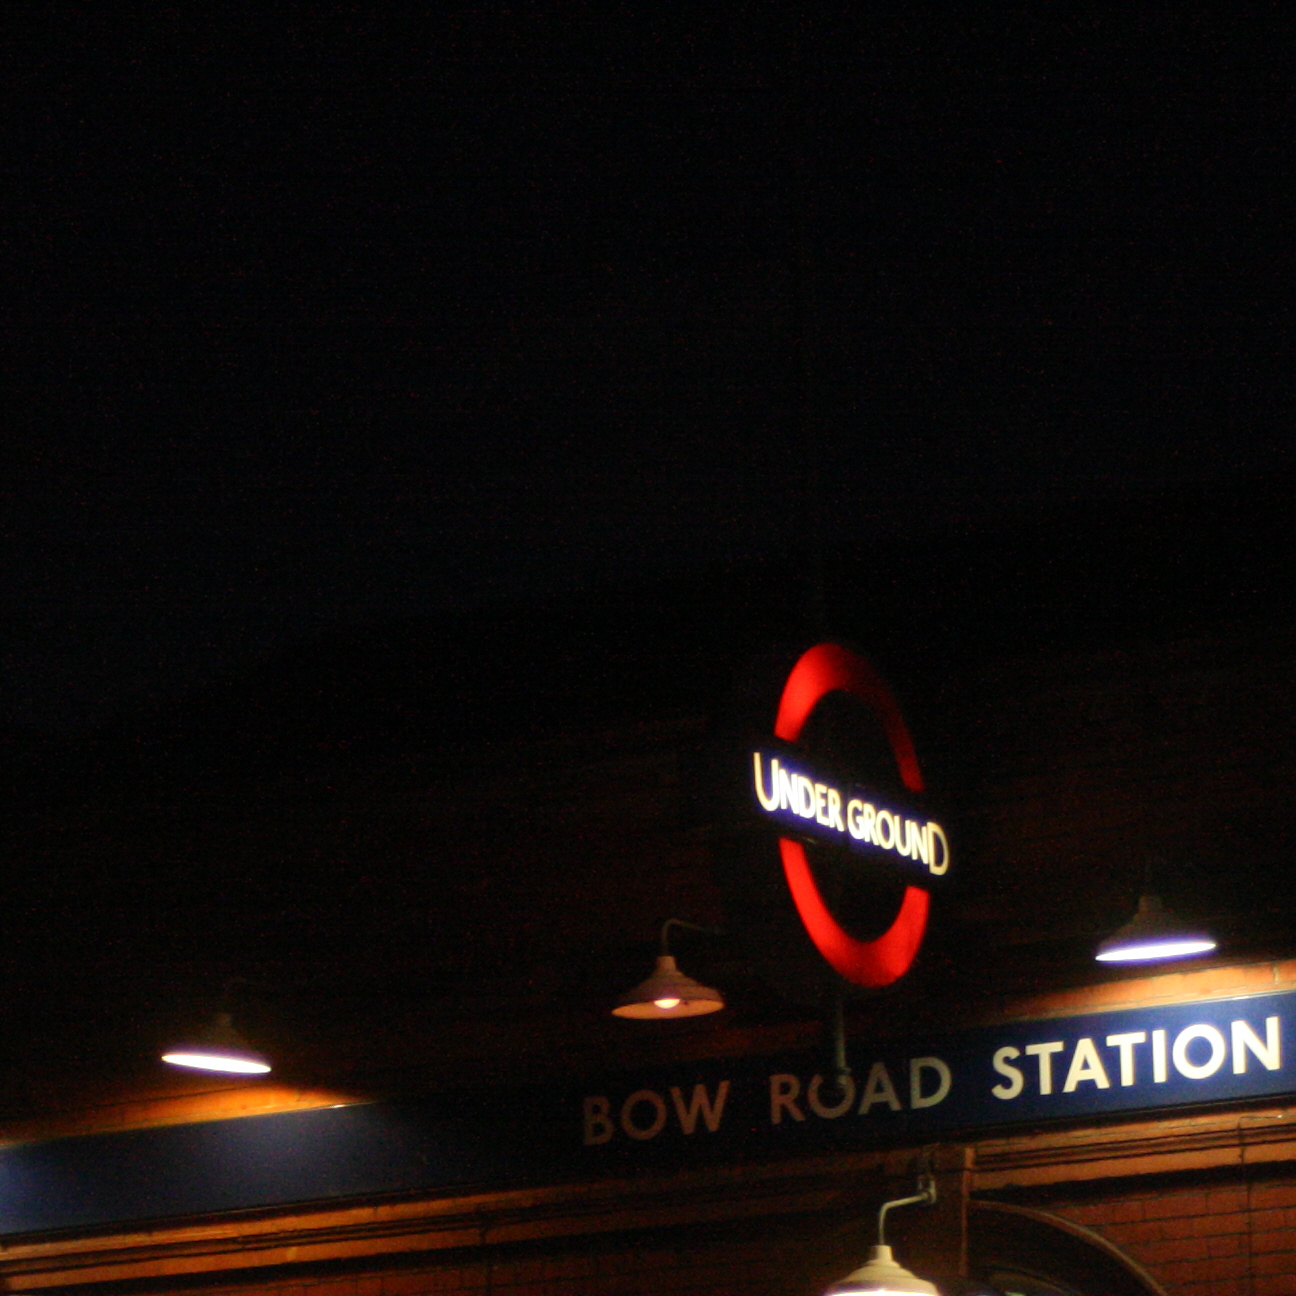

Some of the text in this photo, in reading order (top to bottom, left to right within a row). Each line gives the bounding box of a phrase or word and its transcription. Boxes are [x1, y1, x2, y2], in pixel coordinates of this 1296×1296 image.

[583, 1016, 1283, 1146] BOW ROAD STATION
